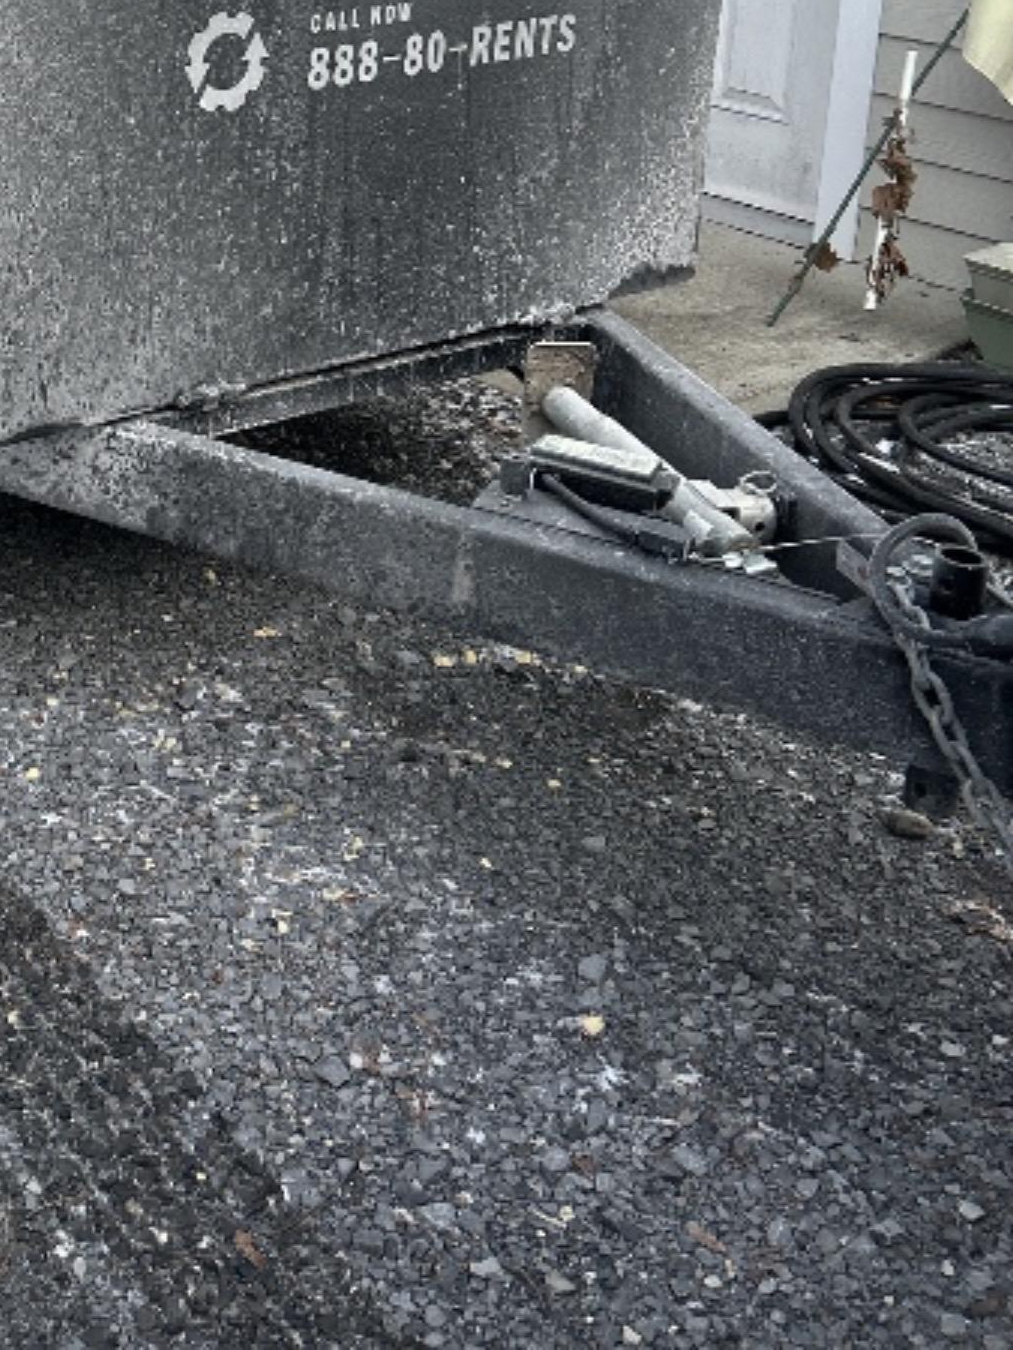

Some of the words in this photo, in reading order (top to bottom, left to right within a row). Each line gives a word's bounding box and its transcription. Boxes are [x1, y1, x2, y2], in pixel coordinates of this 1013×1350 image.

[310, 8, 360, 34] CALL
[370, 2, 412, 26] NOW
[307, 13, 577, 91] 888-80-RENTS
